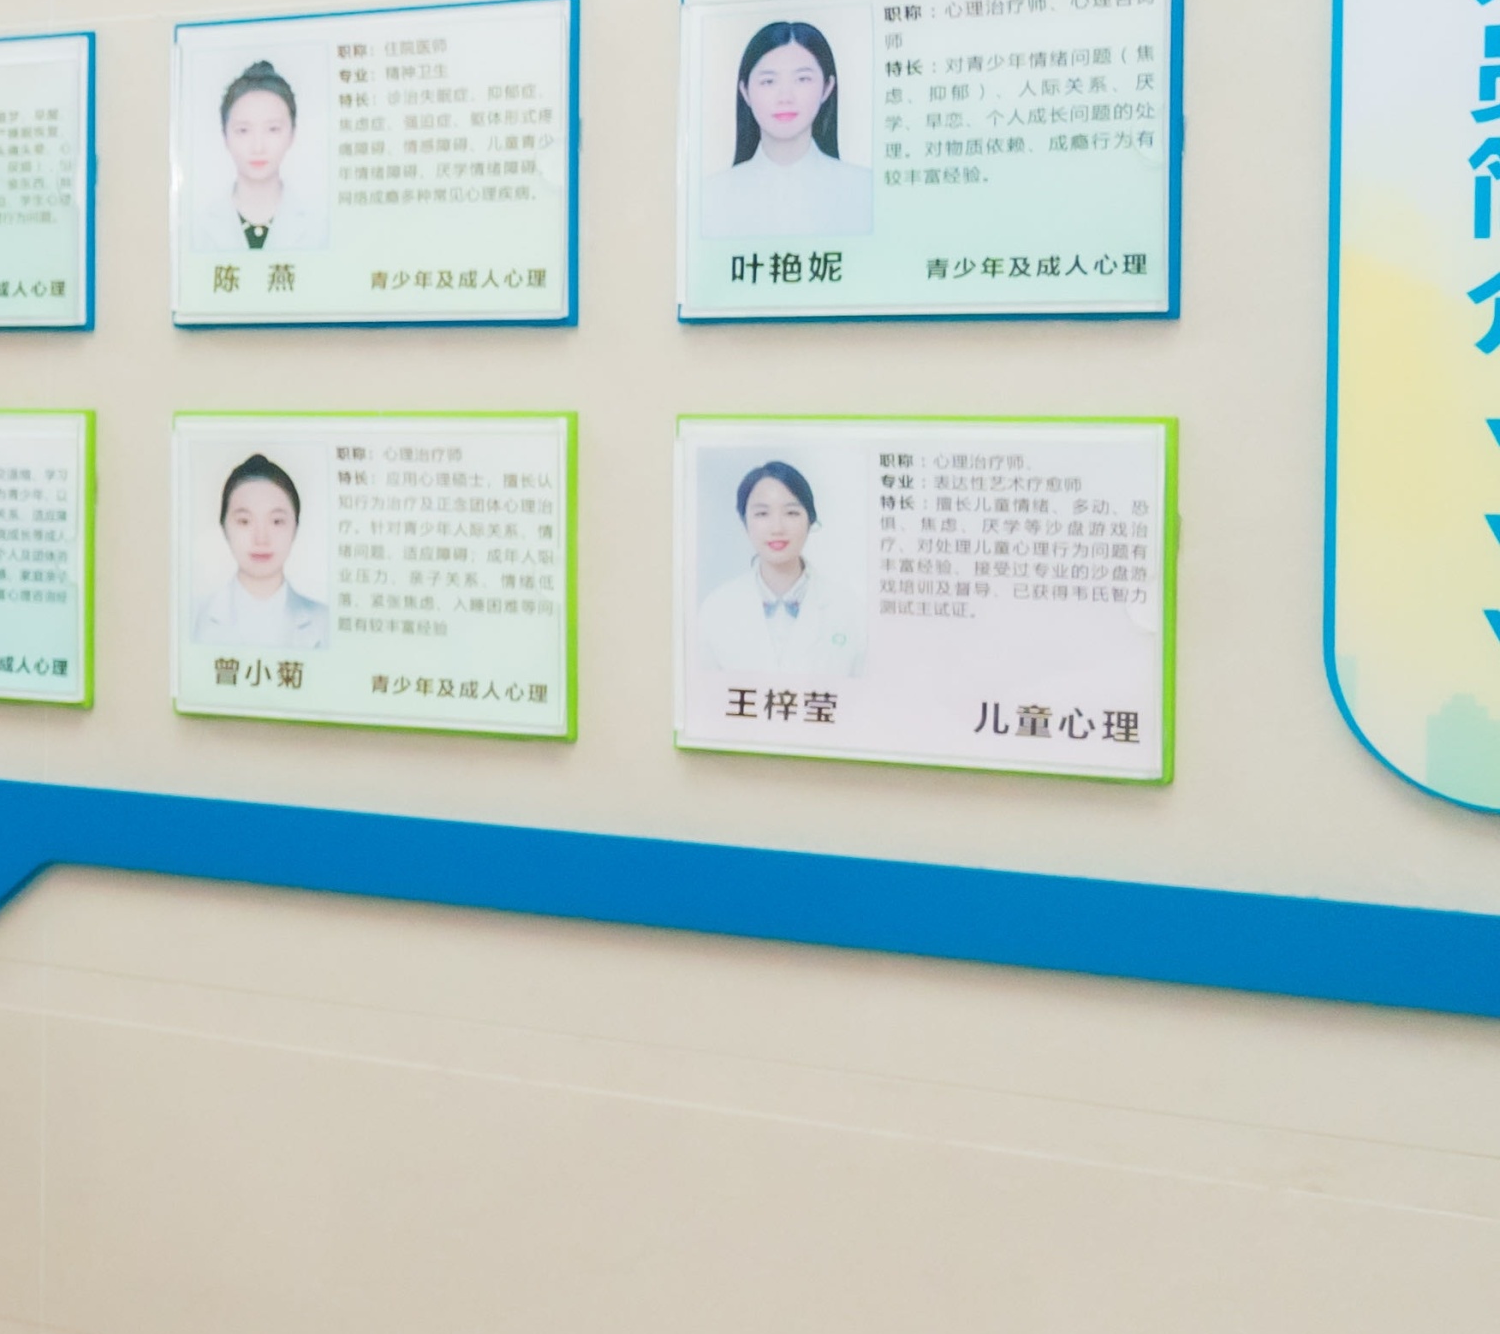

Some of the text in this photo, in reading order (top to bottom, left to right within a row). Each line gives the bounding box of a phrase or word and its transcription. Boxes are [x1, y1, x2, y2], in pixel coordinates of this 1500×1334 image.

[885, 32, 904, 50] 师
[885, 45, 1155, 77] 特长：对青少年情绪问题（焦
[885, 167, 991, 187] 较丰富经验。
[370, 268, 547, 290] 青少年及成人心理
[731, 251, 843, 285] 叶艳妮
[926, 254, 1148, 280] 青少年及成人心理
[881, 474, 1081, 493] 专业：表达性艺术疗愈师
[213, 658, 305, 690] 曾小菊
[371, 674, 548, 703] 青少年及成人心理
[726, 687, 838, 725] 王梓莹
[974, 701, 1140, 744] 儿童心理
